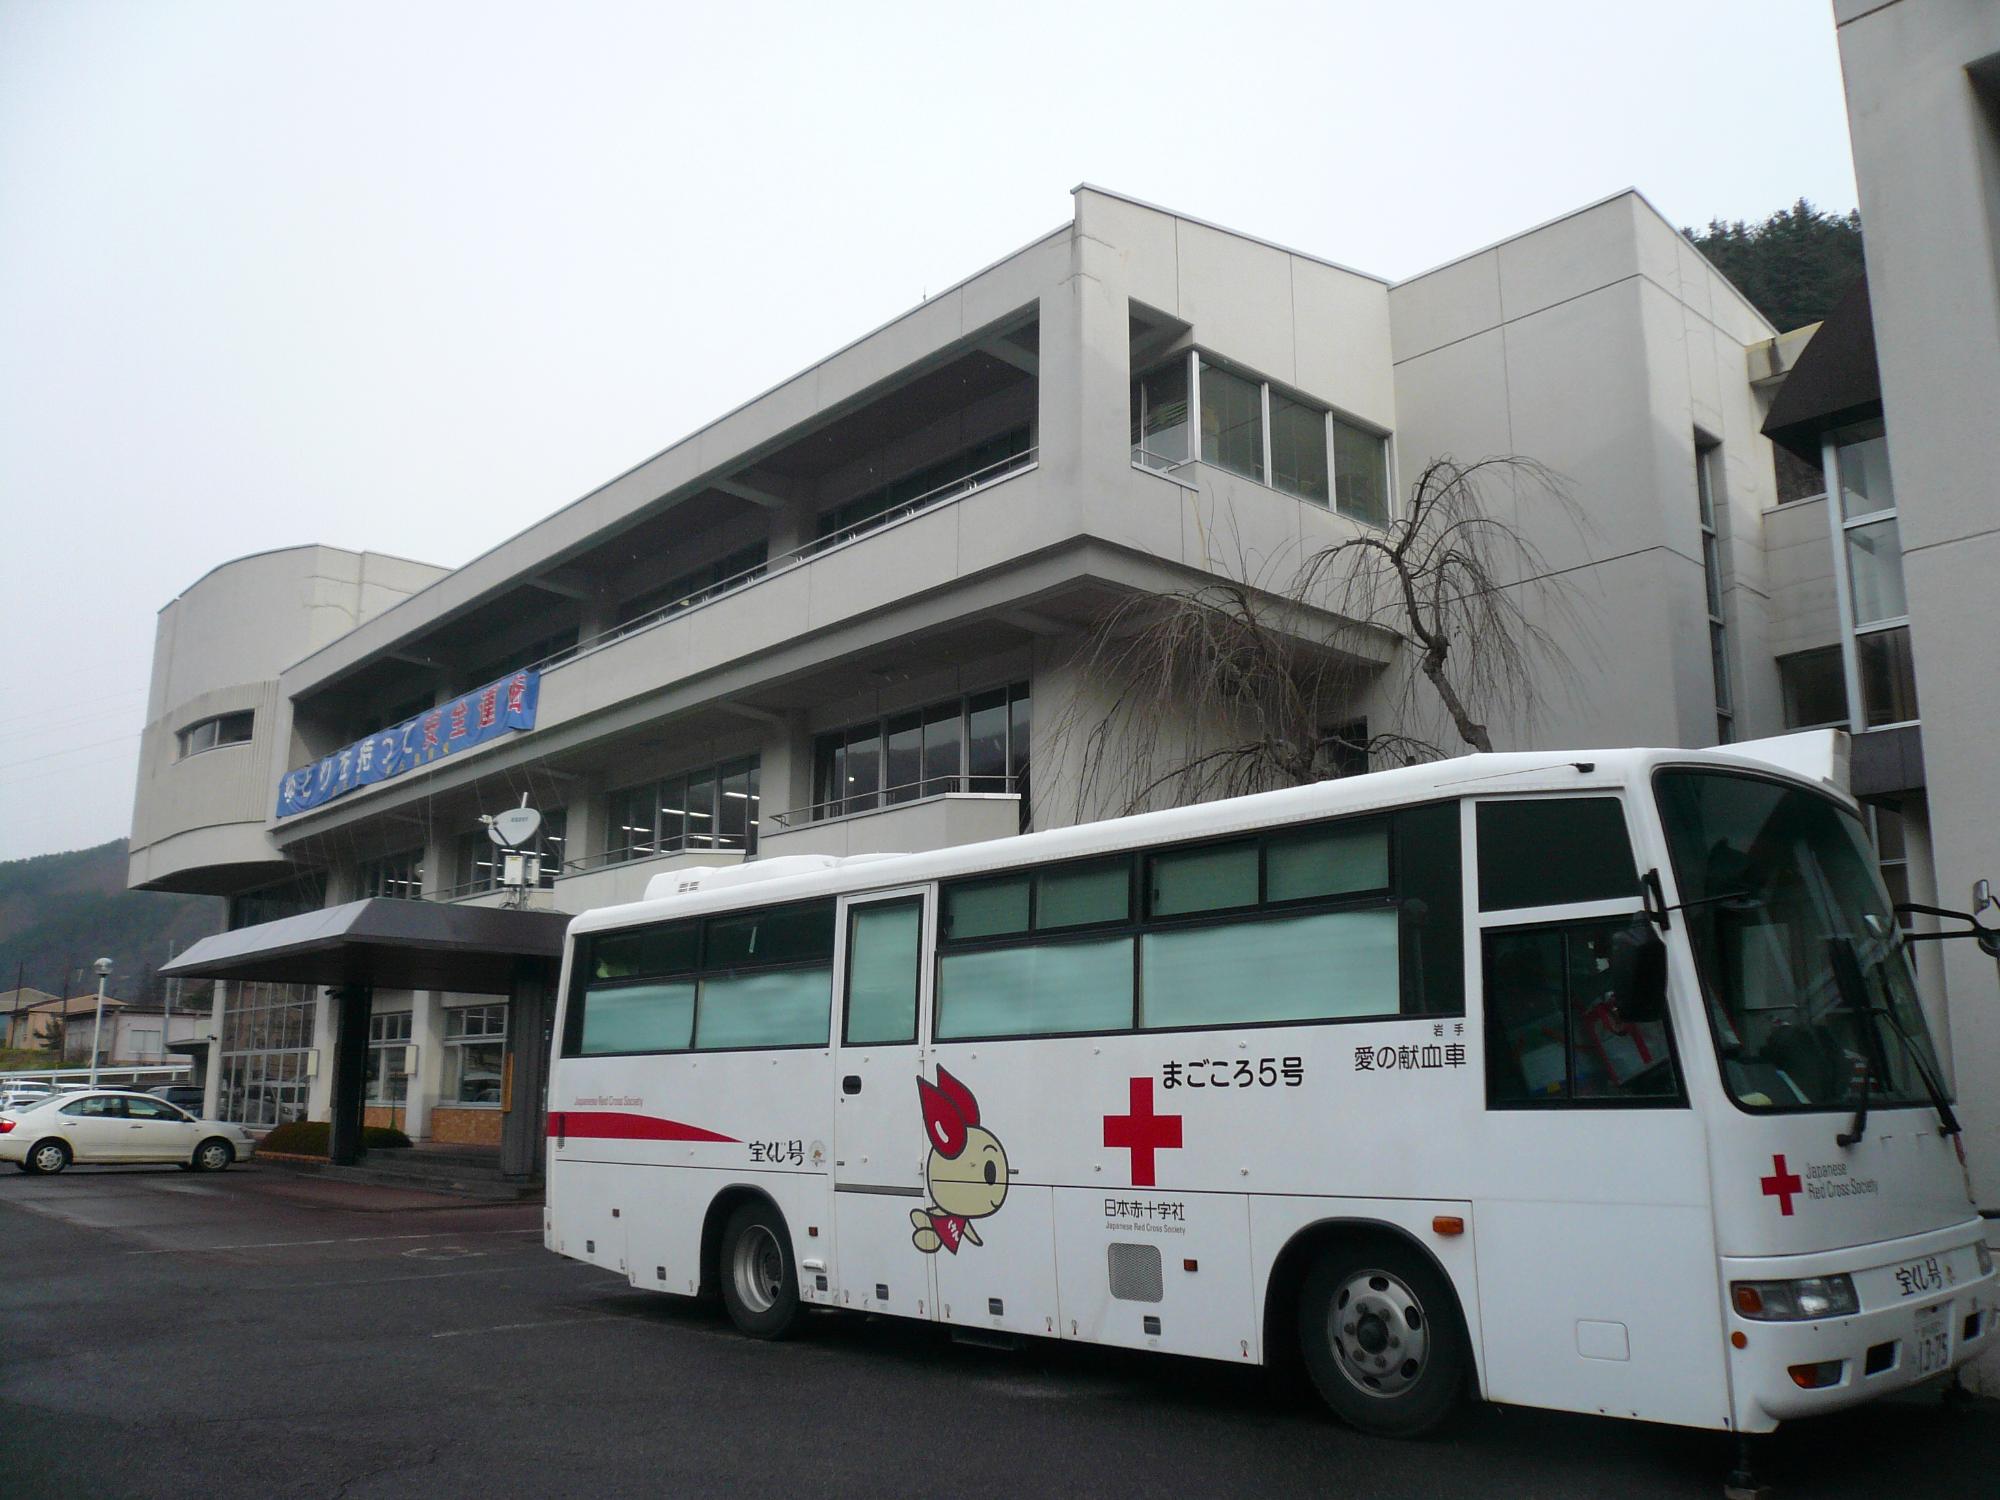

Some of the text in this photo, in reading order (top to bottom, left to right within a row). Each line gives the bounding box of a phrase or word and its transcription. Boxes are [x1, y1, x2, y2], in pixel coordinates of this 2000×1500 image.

[1433, 1023, 1465, 1037] 岩手
[1354, 1043, 1467, 1072] 愛の献血車
[1162, 1056, 1304, 1090] まごころ5号
[748, 1140, 805, 1167] 宝くじ号
[1806, 1163, 1848, 1180] Japanese
[1807, 1177, 1879, 1200] Red Cross Society
[1104, 1198, 1186, 1221] 日本赤十字社
[1105, 1221, 1186, 1236] Japanese Red Cross Society
